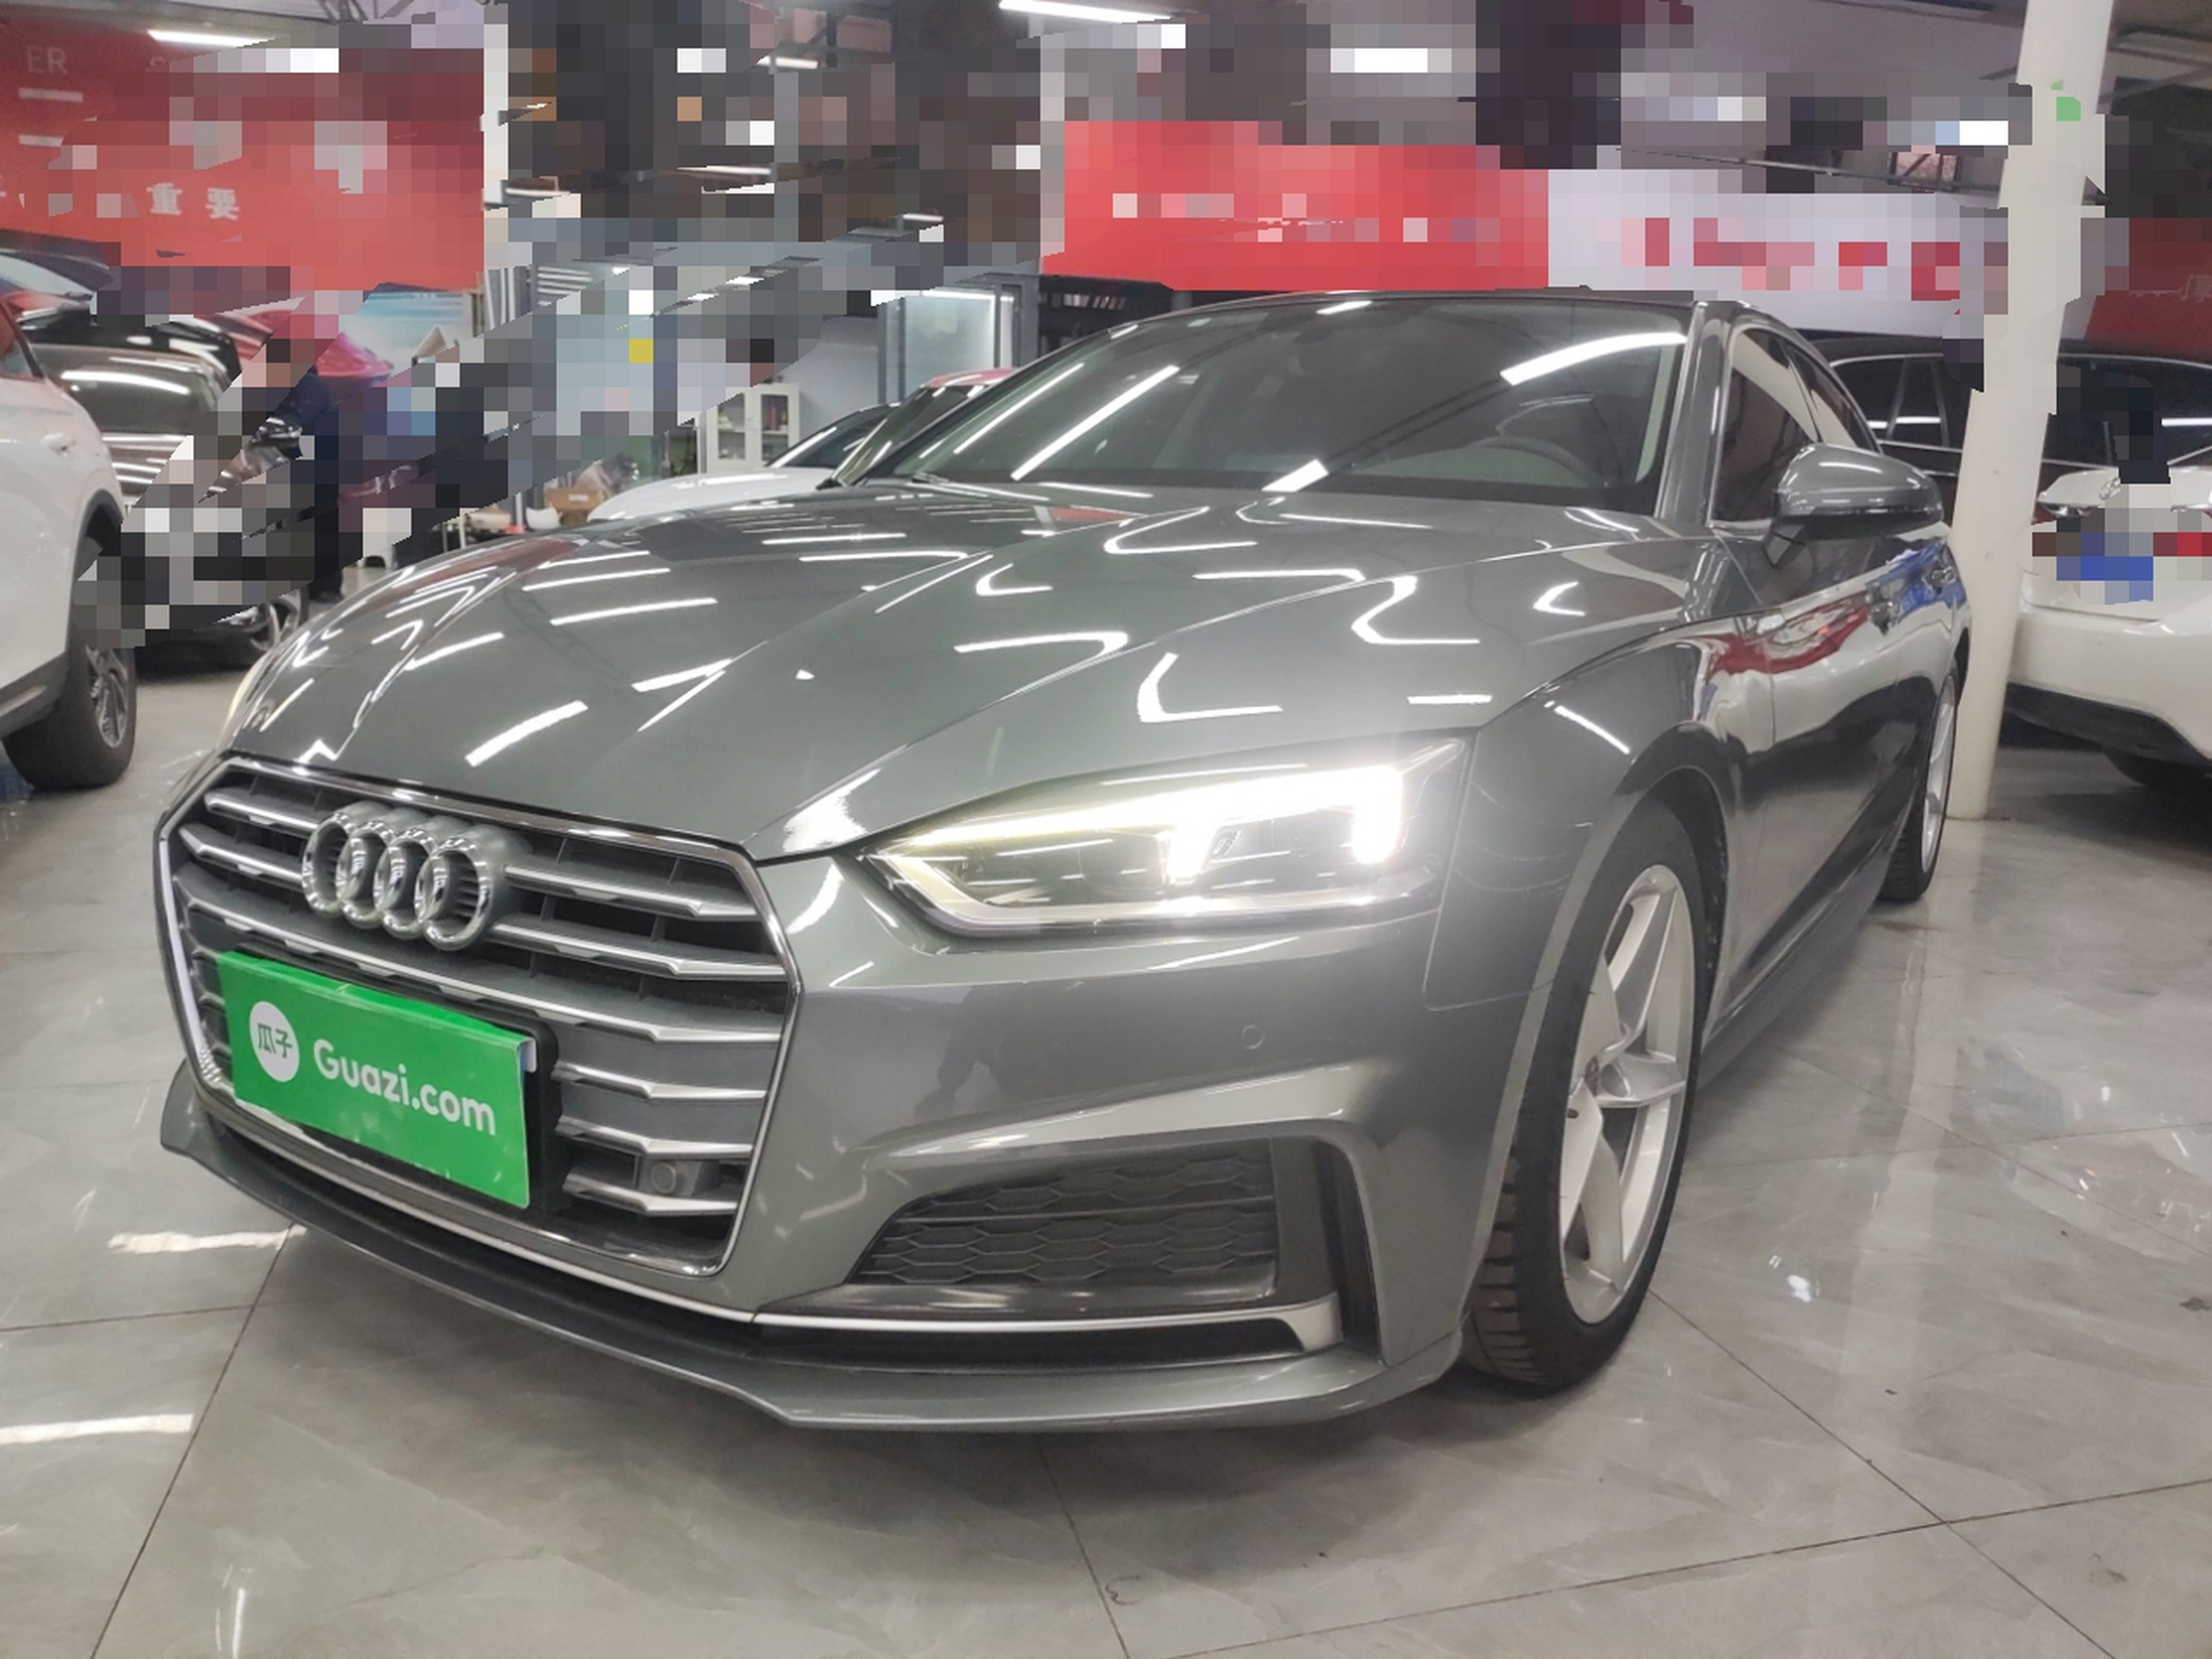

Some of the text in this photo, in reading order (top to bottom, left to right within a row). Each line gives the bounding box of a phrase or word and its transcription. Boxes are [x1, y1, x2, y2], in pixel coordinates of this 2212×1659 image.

[146, 181, 240, 220] 重要
[257, 1022, 293, 1058] 瓜子
[313, 1038, 496, 1136] Guazi.com
